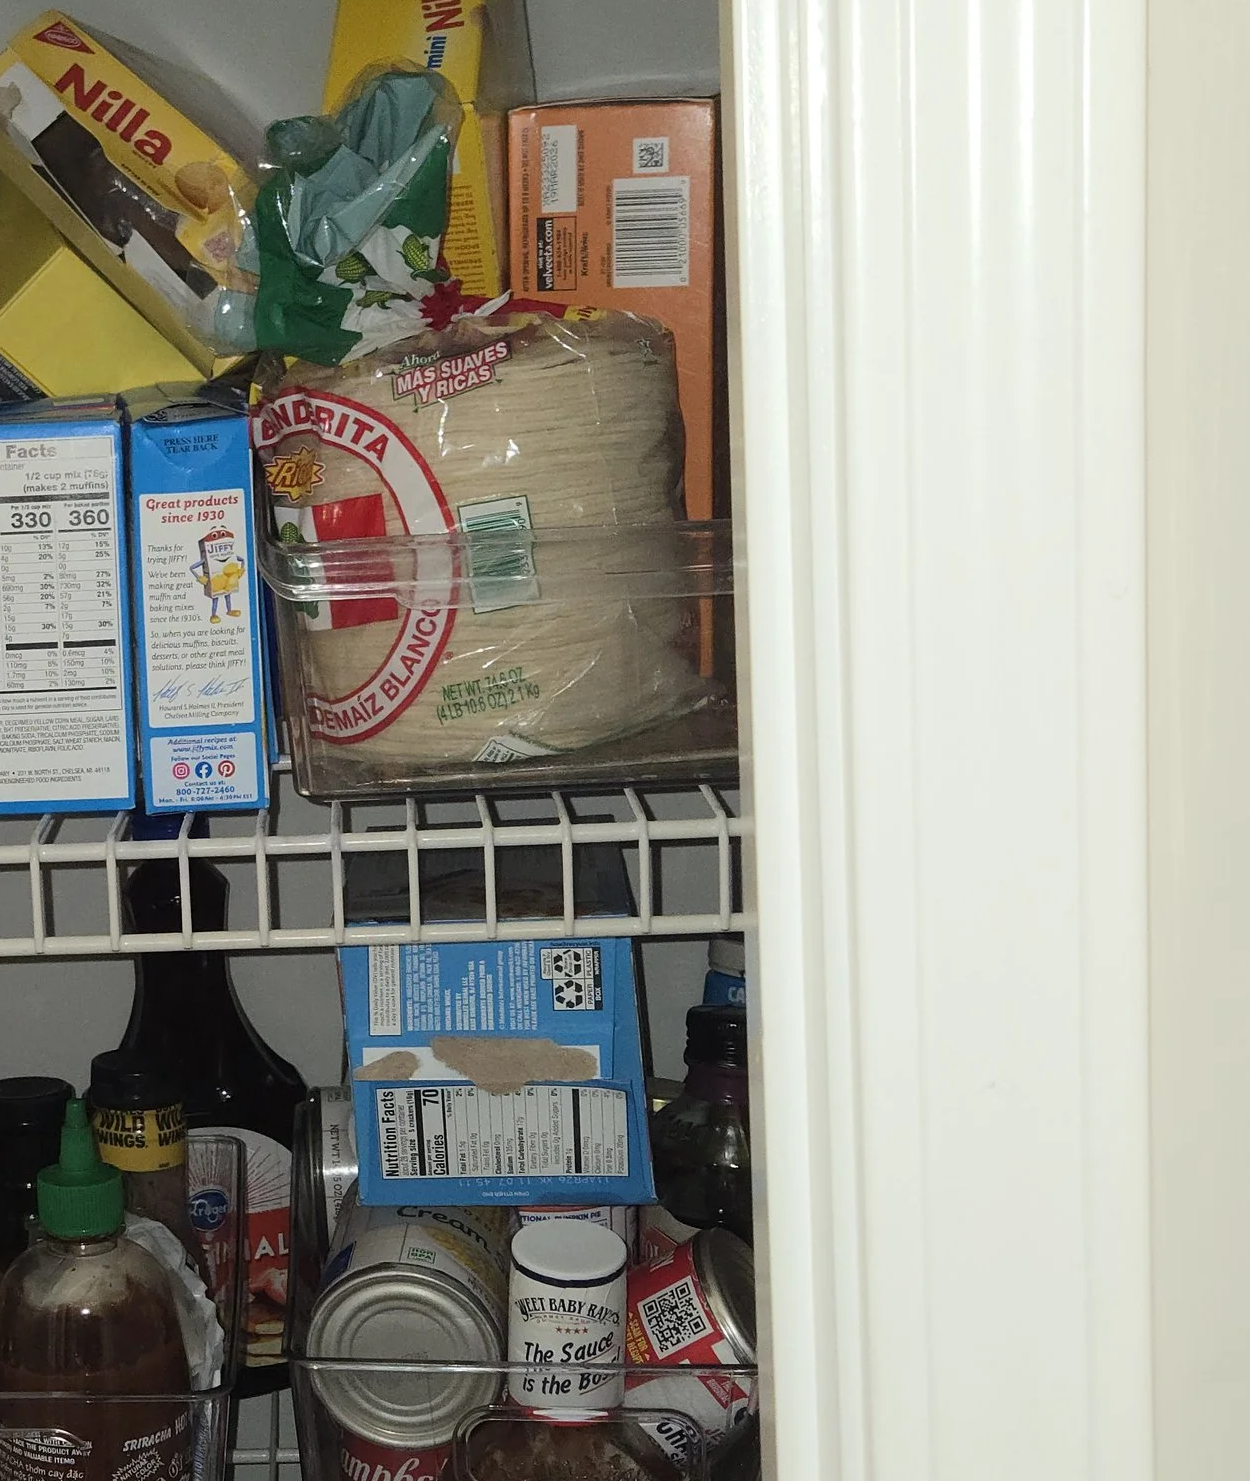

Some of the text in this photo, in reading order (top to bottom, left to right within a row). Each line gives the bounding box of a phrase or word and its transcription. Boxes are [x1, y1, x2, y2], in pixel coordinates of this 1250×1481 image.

[424, 36, 447, 69] mini
[54, 63, 172, 165] Nilla
[545, 220, 553, 289] velveeta.com
[396, 341, 508, 395] MÁS SUAVES
[401, 351, 440, 368] Ahora
[419, 365, 492, 404] Y RICAS
[6, 444, 58, 459] Facts
[164, 434, 219, 447] PRESS HERE
[146, 495, 239, 511] Great products
[11, 511, 52, 529] 330
[68, 509, 110, 527] 360
[162, 510, 225, 524] since 1930
[336, 692, 384, 731] MAÍZ
[176, 786, 235, 796] 800-727-2460
[100, 1111, 146, 1133] WILD
[382, 1090, 400, 1177] Nutrition Facts
[422, 1089, 446, 1175] Calories 70
[525, 1332, 614, 1363] The Sauce
[523, 1374, 571, 1394] is the
[122, 1428, 172, 1452] SRIRACHA
